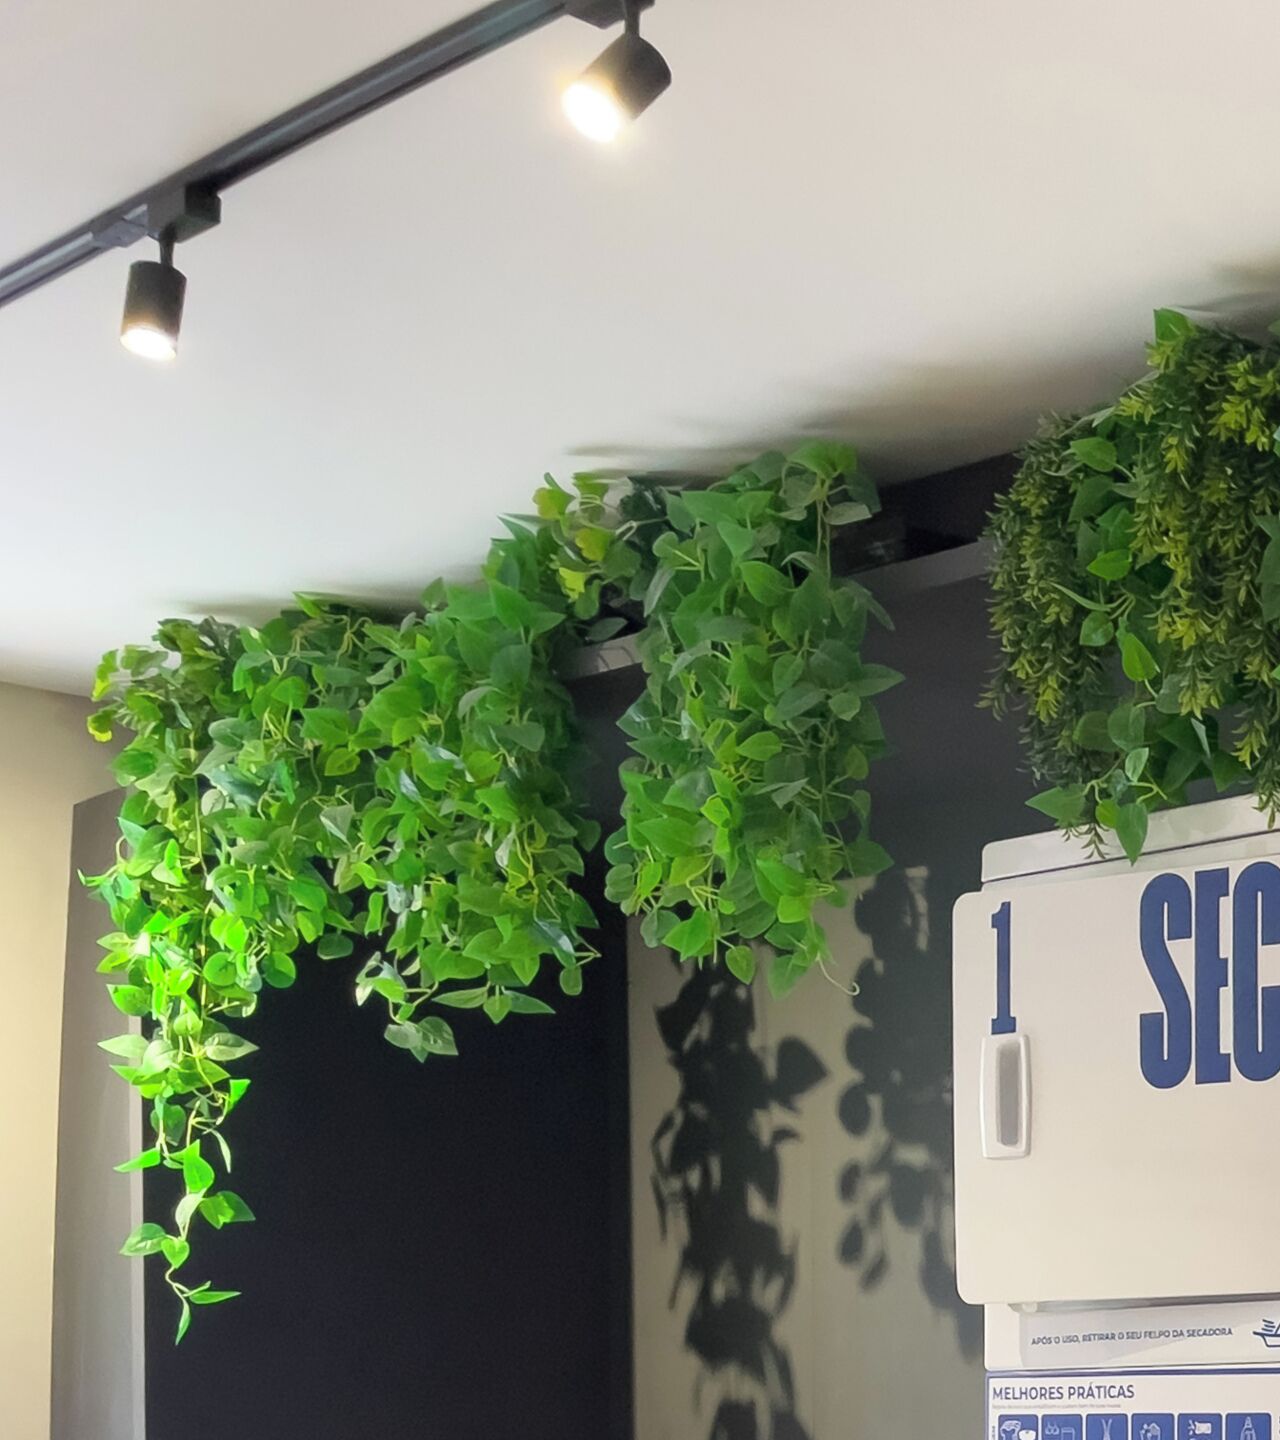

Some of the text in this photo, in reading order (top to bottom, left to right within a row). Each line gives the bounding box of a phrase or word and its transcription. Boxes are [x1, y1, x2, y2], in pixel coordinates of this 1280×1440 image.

[991, 901, 1017, 1035] 1
[1082, 1333, 1115, 1342] RETIRAR
[1126, 1332, 1142, 1340] SEU
[1173, 1330, 1185, 1338] DA
[1187, 1328, 1232, 1337] SECADORA
[992, 1382, 1134, 1400] MELHORES PRÁTICAS
